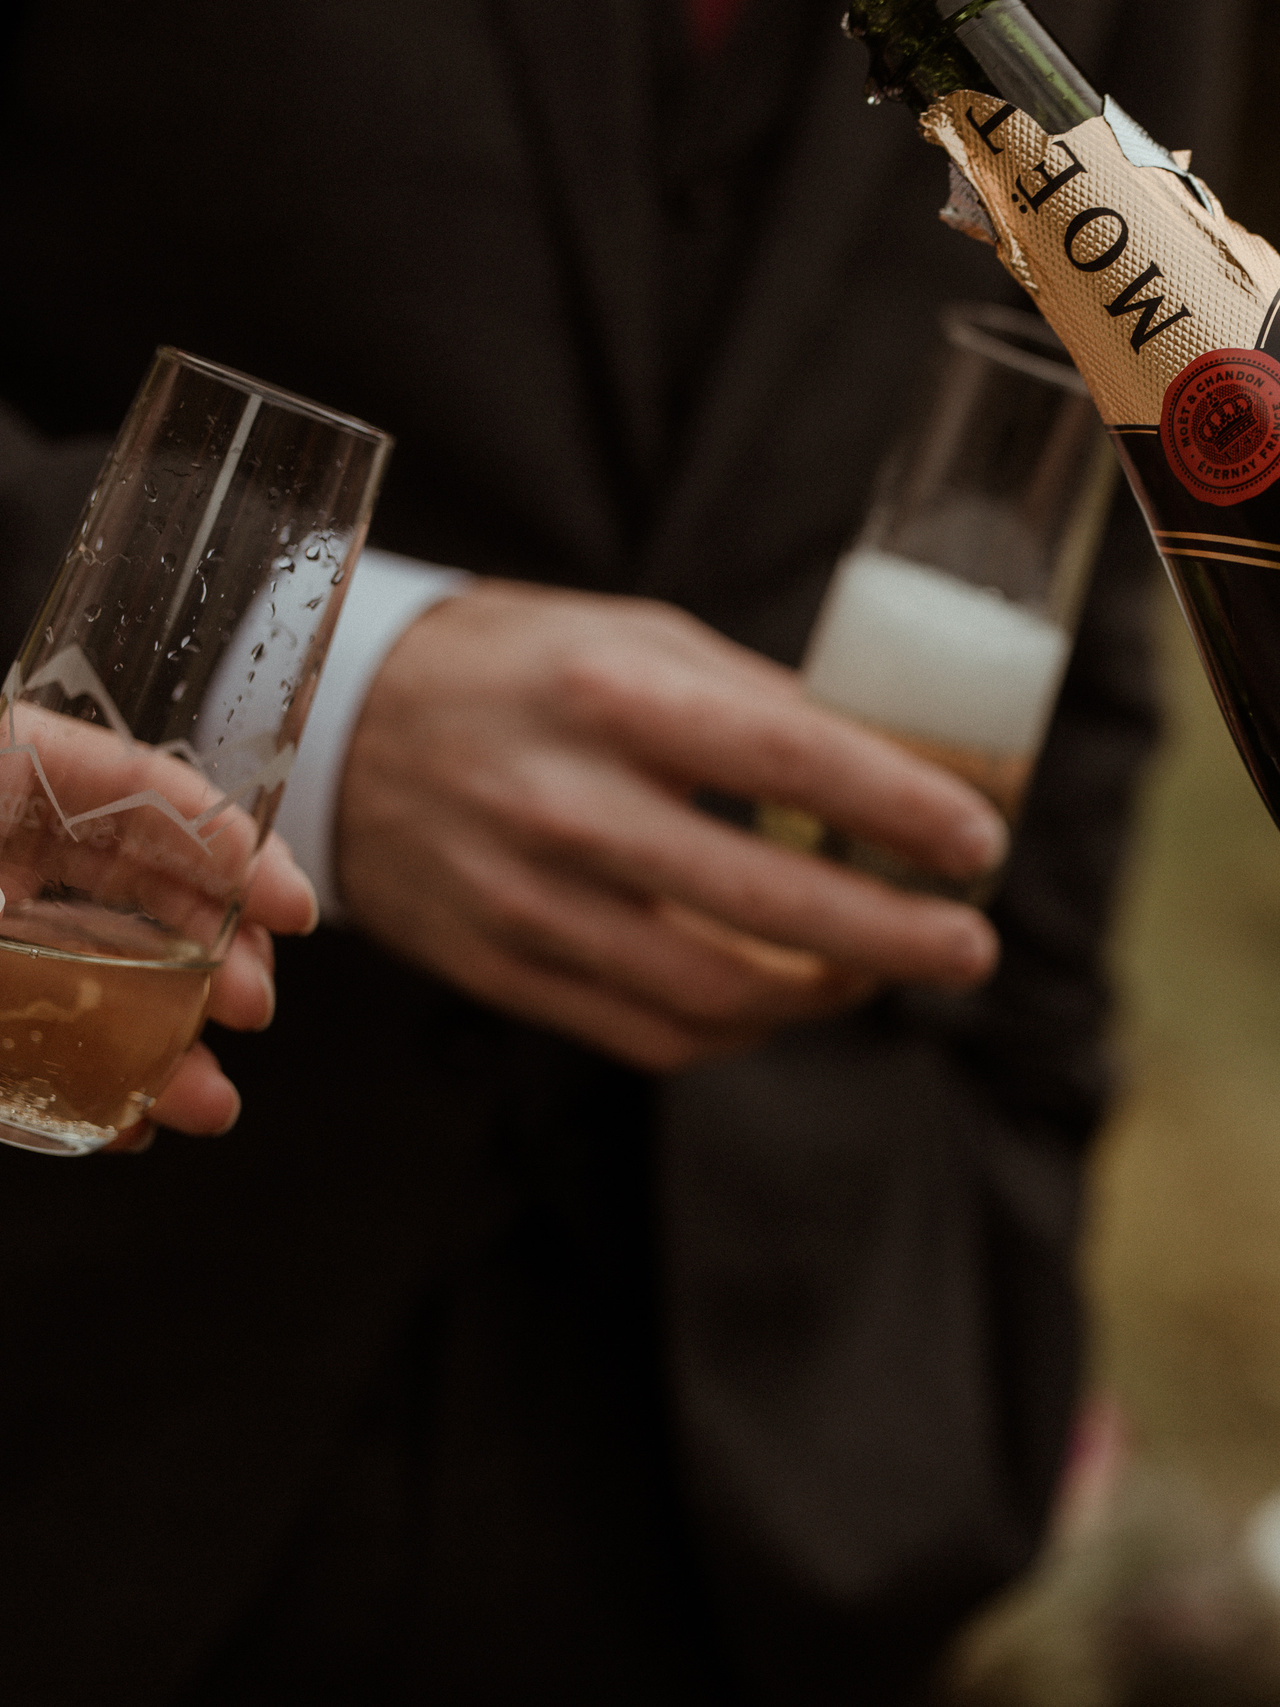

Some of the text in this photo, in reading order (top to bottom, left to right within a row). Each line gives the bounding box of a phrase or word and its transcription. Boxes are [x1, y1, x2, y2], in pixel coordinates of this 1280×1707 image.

[965, 104, 1192, 354] MOËT
[1177, 370, 1266, 448] MOËT & CHANDON
[1197, 459, 1257, 480] ÉPERNAY
